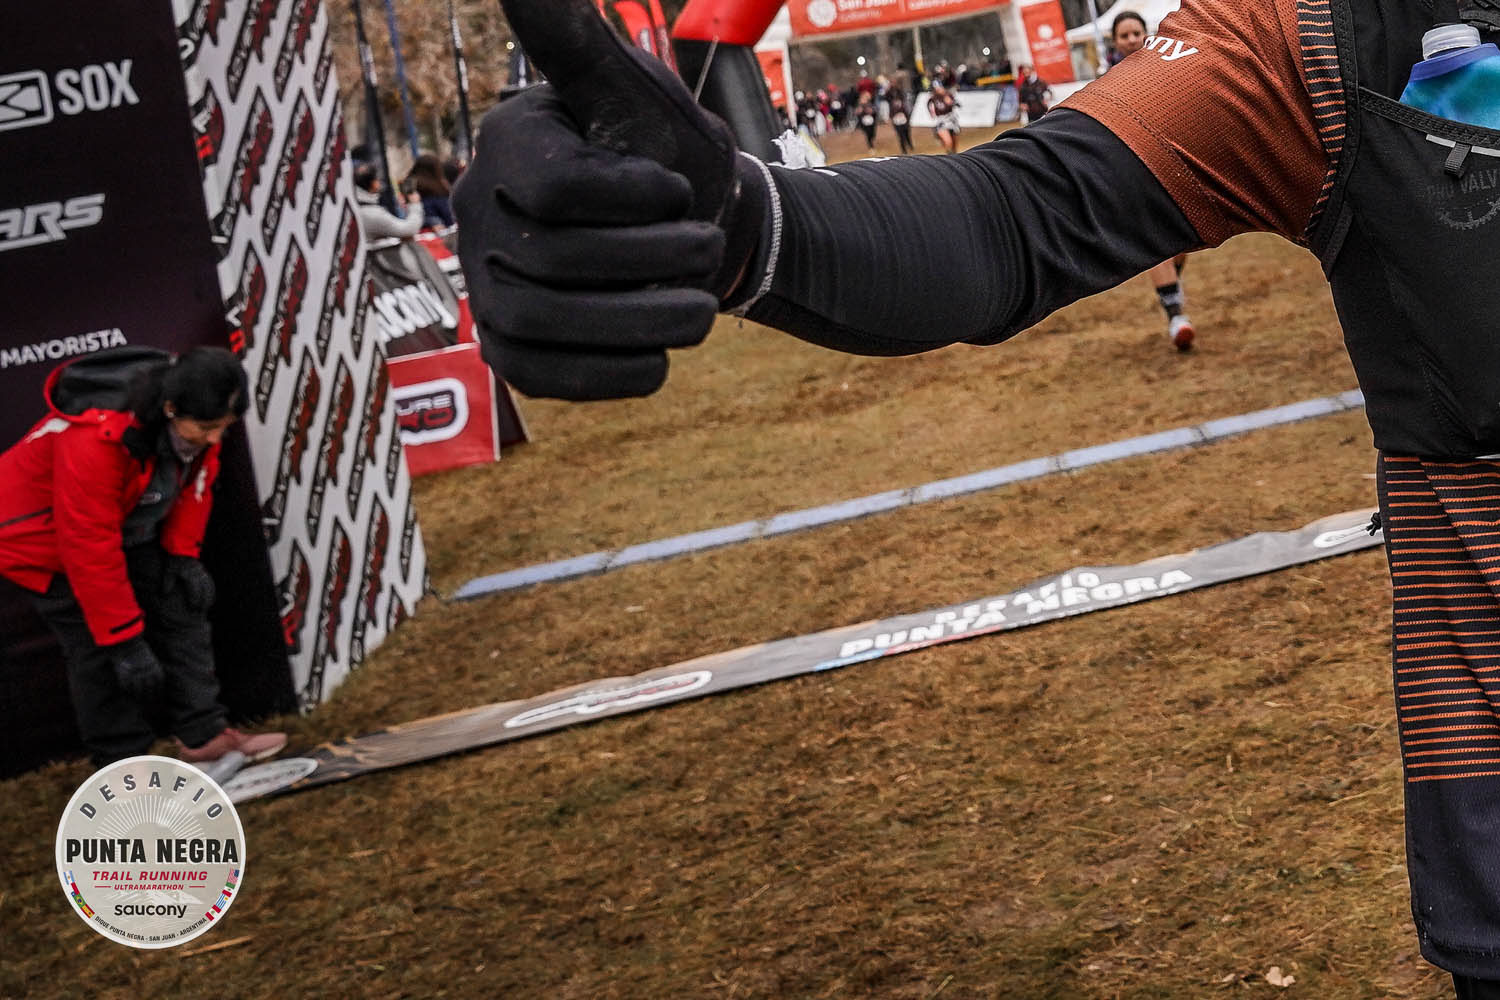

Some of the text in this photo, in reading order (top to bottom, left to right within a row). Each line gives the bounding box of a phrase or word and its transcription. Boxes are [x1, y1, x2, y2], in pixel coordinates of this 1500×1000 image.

[55, 58, 140, 115] SOX
[1, 328, 127, 368] MAYORISTA
[839, 609, 1007, 659] PUNTA
